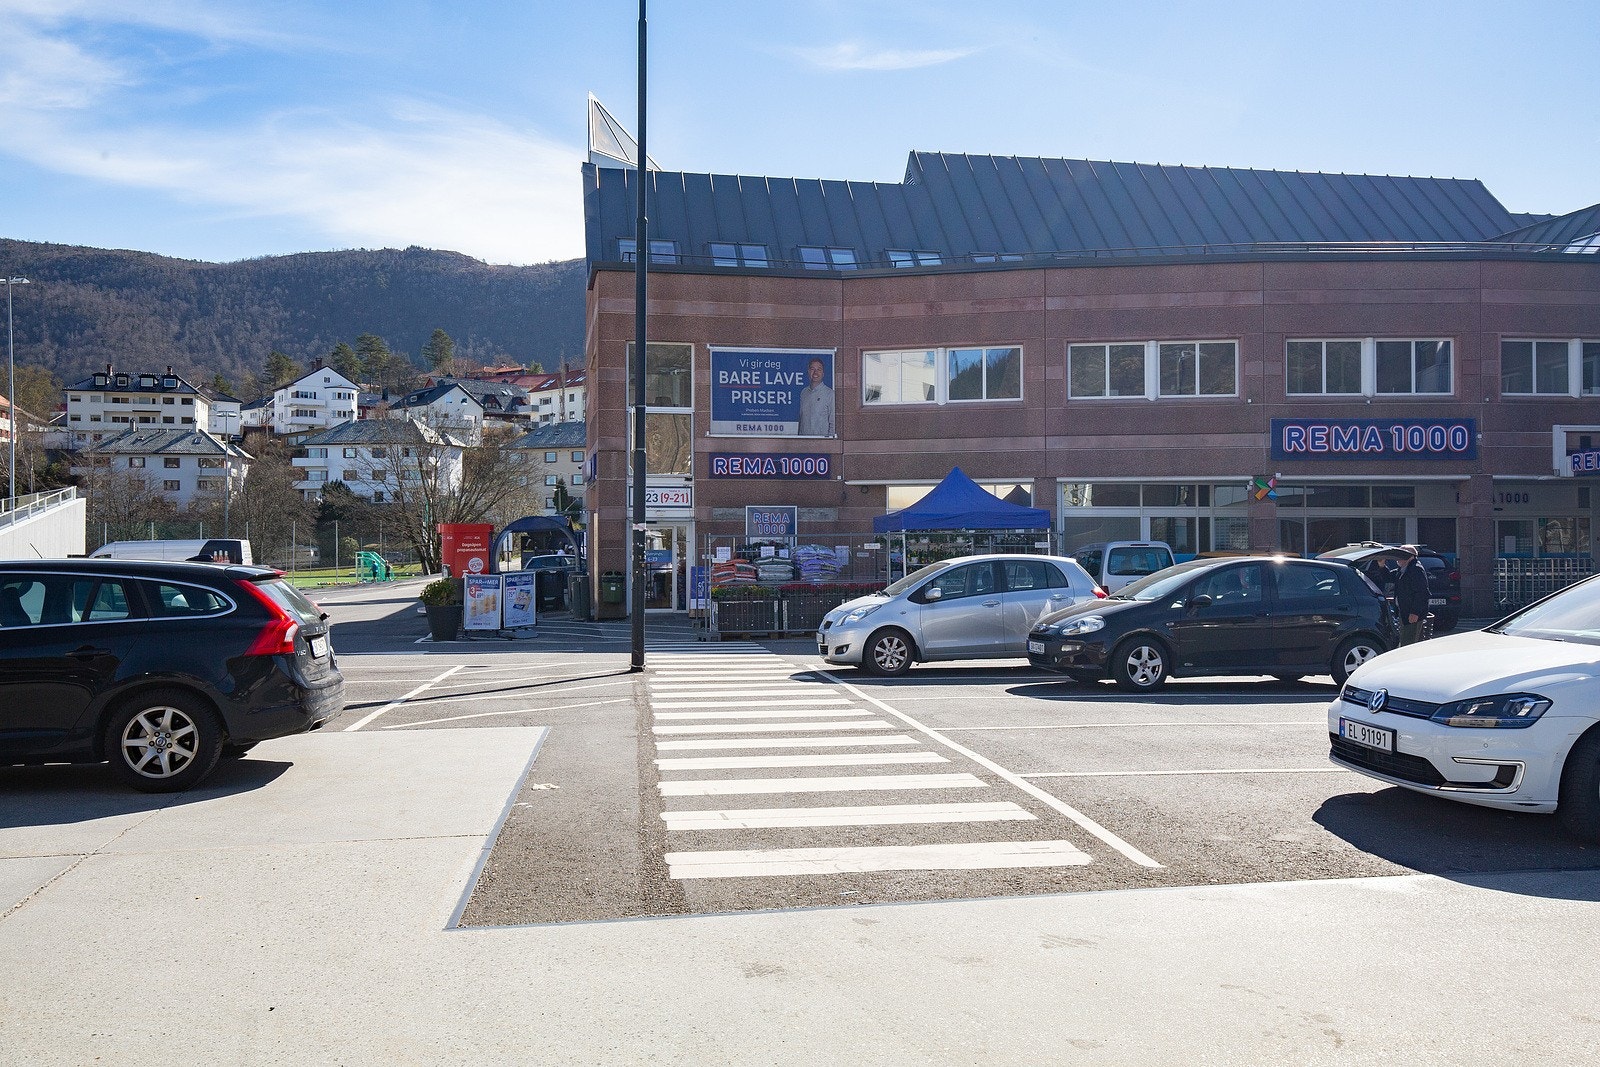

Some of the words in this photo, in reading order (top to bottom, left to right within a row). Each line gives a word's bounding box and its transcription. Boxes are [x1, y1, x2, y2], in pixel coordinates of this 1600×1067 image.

[739, 358, 749, 368] Vi
[750, 359, 763, 369] gir
[764, 359, 781, 370] deg
[719, 370, 761, 385] BARE
[765, 371, 804, 386] LAVE
[731, 390, 792, 405] PRISER!
[736, 423, 762, 432] REMA
[764, 424, 784, 432] 1000
[1282, 425, 1384, 452] REMA
[1389, 425, 1468, 452] 1000
[713, 457, 777, 475] REMA
[780, 458, 828, 475] 1000
[1570, 452, 1600, 472] RE
[660, 492, 689, 503] (9-21)
[753, 512, 790, 524] REMA
[757, 524, 786, 534] 1000
[1348, 723, 1358, 739] EL
[1361, 726, 1386, 748] 91191
